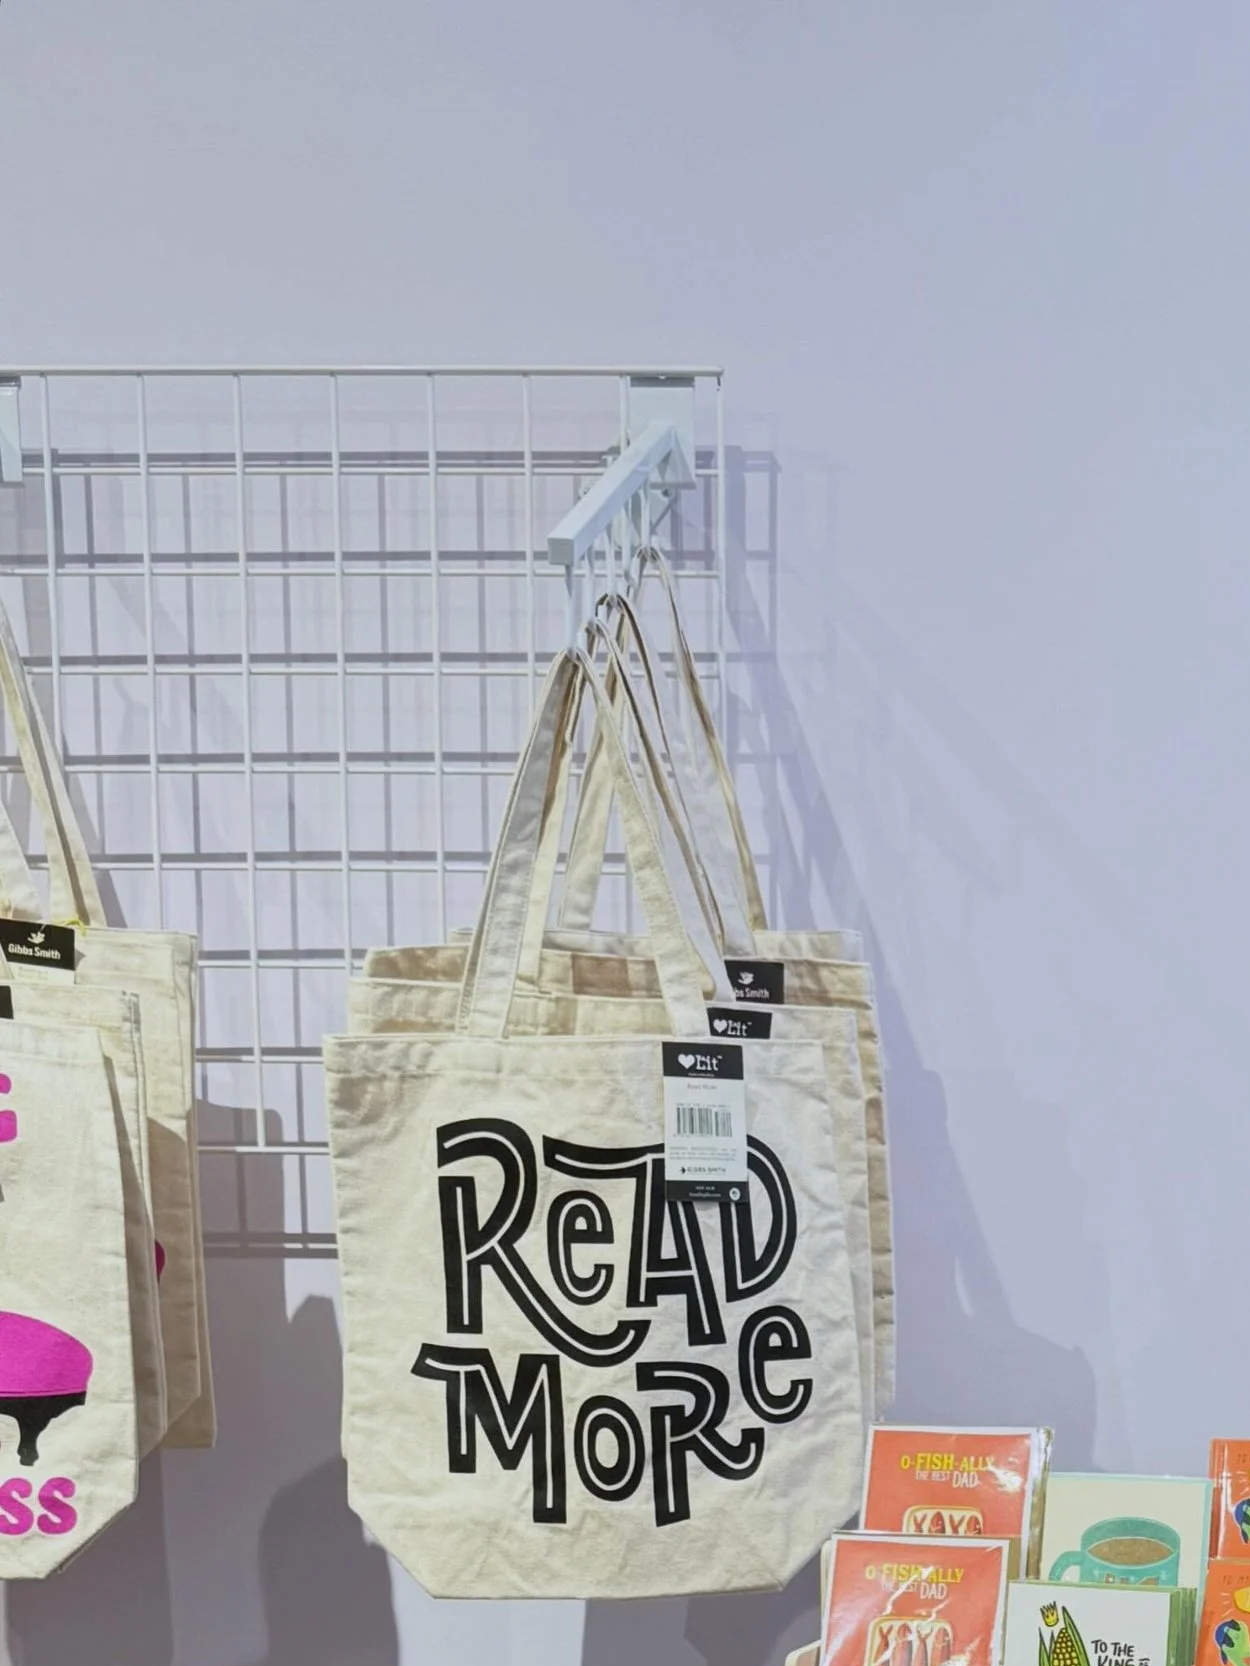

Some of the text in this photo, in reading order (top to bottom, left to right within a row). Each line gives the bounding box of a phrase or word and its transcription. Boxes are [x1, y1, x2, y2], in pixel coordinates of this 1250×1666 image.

[8, 943, 62, 960] Gibbs Smith
[952, 1471, 978, 1488] DAD
[919, 1582, 948, 1600] DAD
[1091, 1639, 1135, 1657] TO THE
